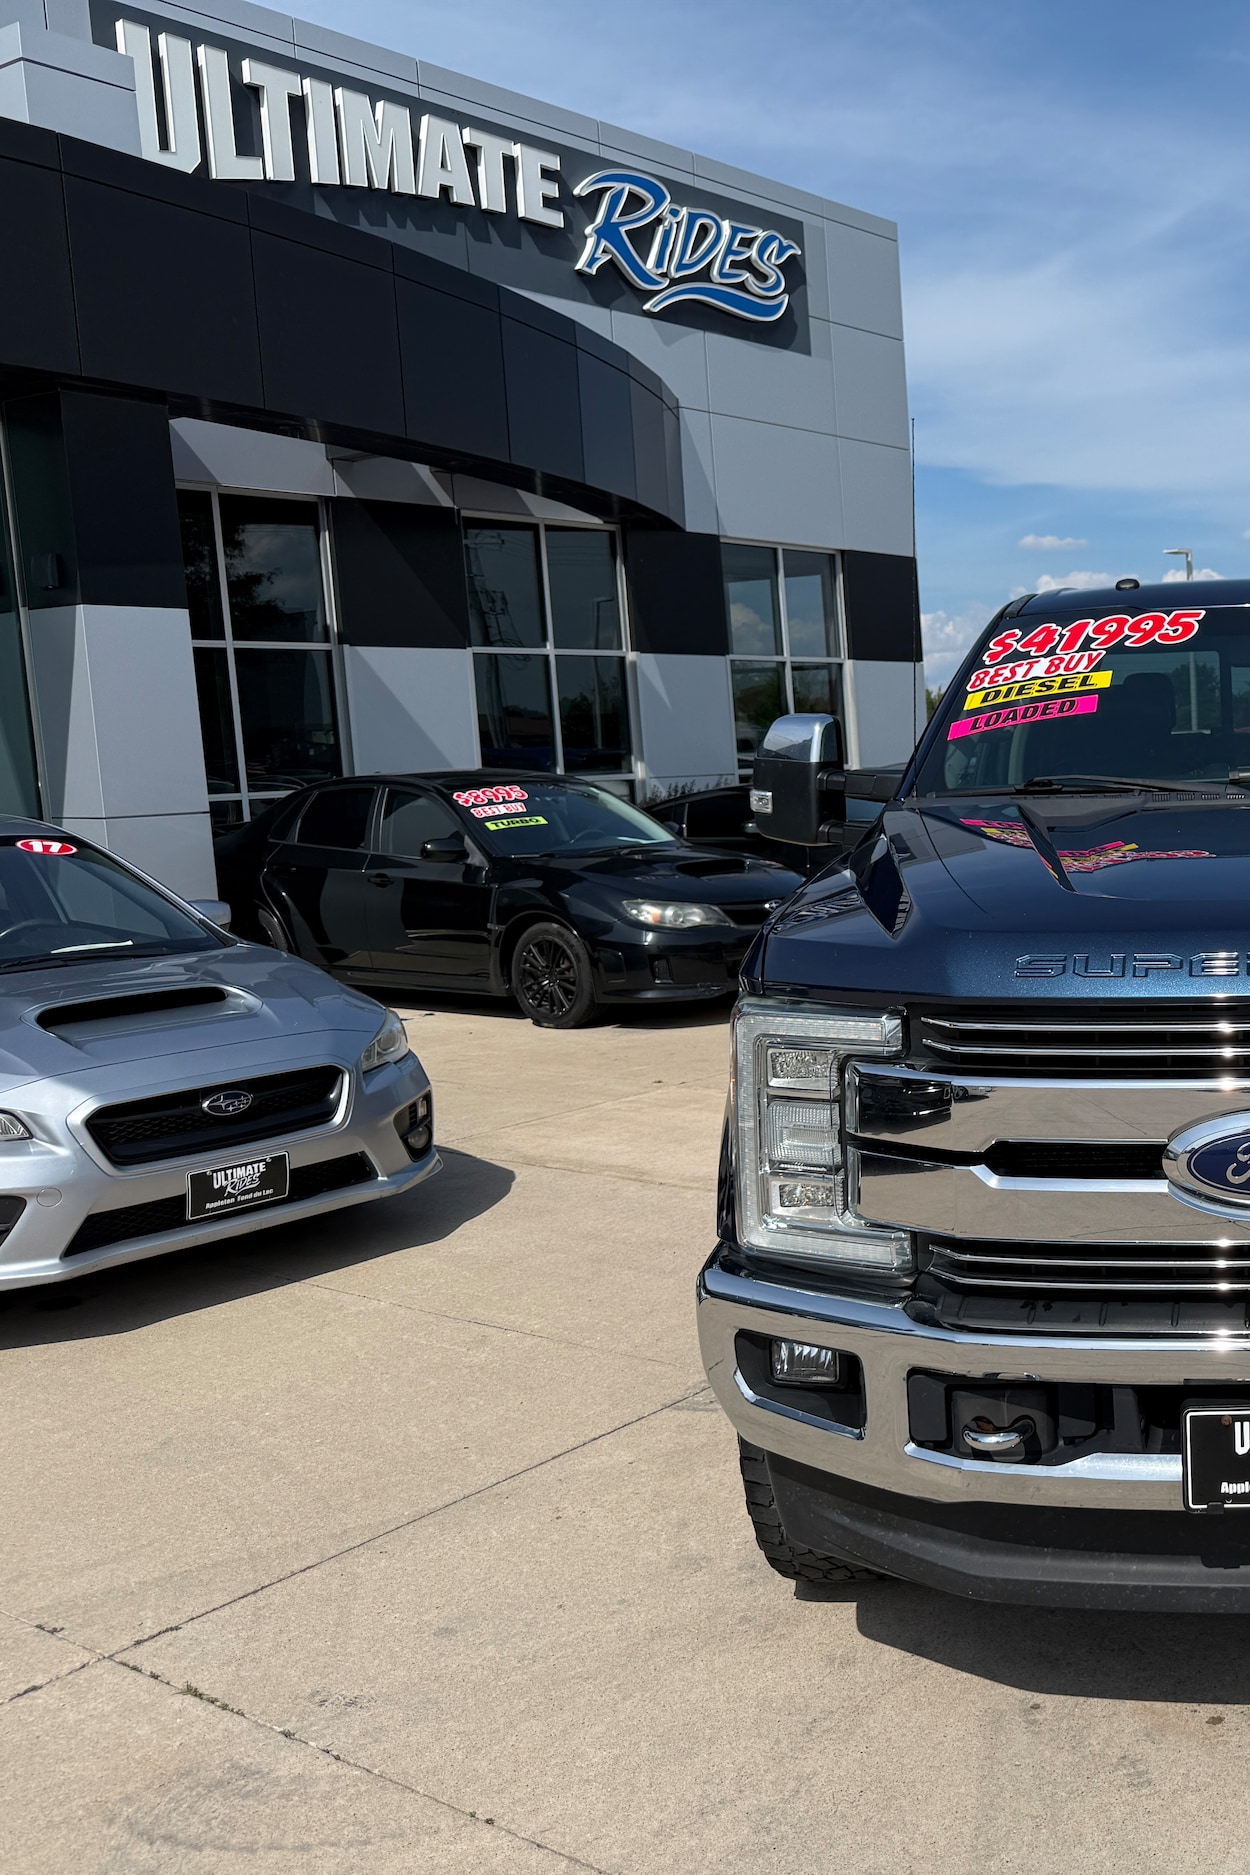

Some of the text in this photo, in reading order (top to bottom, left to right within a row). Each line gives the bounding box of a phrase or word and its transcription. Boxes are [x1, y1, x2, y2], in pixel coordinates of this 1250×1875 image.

[116, 19, 564, 228] ULTIMATE
[983, 610, 1206, 664] $41995
[970, 651, 1105, 691] BEST BUY
[979, 674, 1098, 706] DIESEL
[969, 699, 1079, 732] LOADED
[453, 785, 528, 806] $8995
[471, 802, 527, 818] BEST BUY
[490, 817, 541, 828] TURBO
[28, 841, 62, 853] 17
[213, 1162, 266, 1189] ULTIMATE
